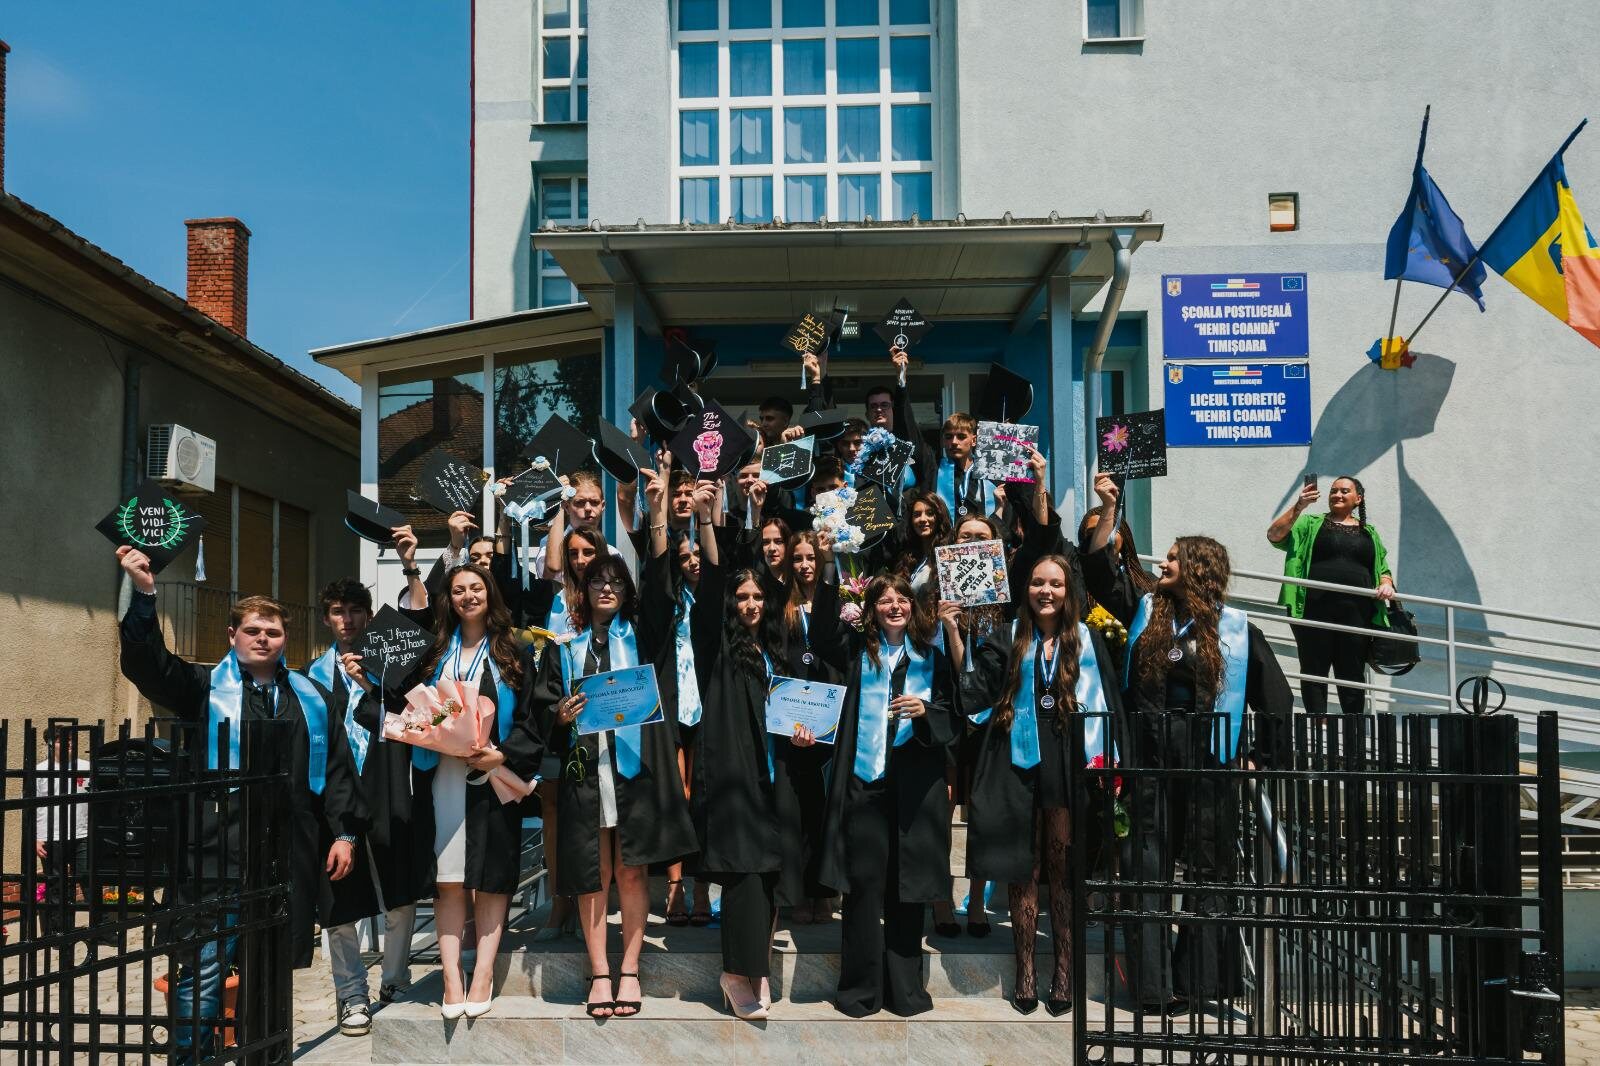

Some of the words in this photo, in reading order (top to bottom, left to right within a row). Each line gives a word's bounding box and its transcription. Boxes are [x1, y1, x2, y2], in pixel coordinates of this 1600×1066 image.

[1181, 306, 1222, 322] ȘCOALA
[1224, 302, 1292, 318] POSTLICEALĂ
[1194, 322, 1230, 336] “HENRI
[1232, 320, 1280, 335] COANDĂ”
[1208, 340, 1267, 356] TIMIȘOARA
[1190, 394, 1229, 406] LICEUL
[1231, 393, 1286, 406] TEORETIC
[703, 412, 719, 421] The
[1190, 410, 1230, 422] “HENRI
[1233, 407, 1286, 422] COANDĂ”
[702, 421, 721, 430] End
[1206, 426, 1272, 442] TIMIȘOARA
[140, 507, 164, 516] VENI
[142, 518, 164, 527] VIDI
[142, 529, 163, 537] VICI
[955, 559, 977, 582] GETTING
[957, 559, 968, 571] OLD
[977, 561, 986, 571] SO
[960, 574, 975, 594] SCARY
[970, 572, 988, 590] FEELS
[387, 629, 393, 640] I
[396, 628, 420, 640] know
[362, 646, 377, 657] the
[380, 642, 400, 660] plans
[400, 640, 406, 650] I
[408, 639, 427, 649] have
[385, 654, 399, 665] for
[400, 652, 416, 666] you
